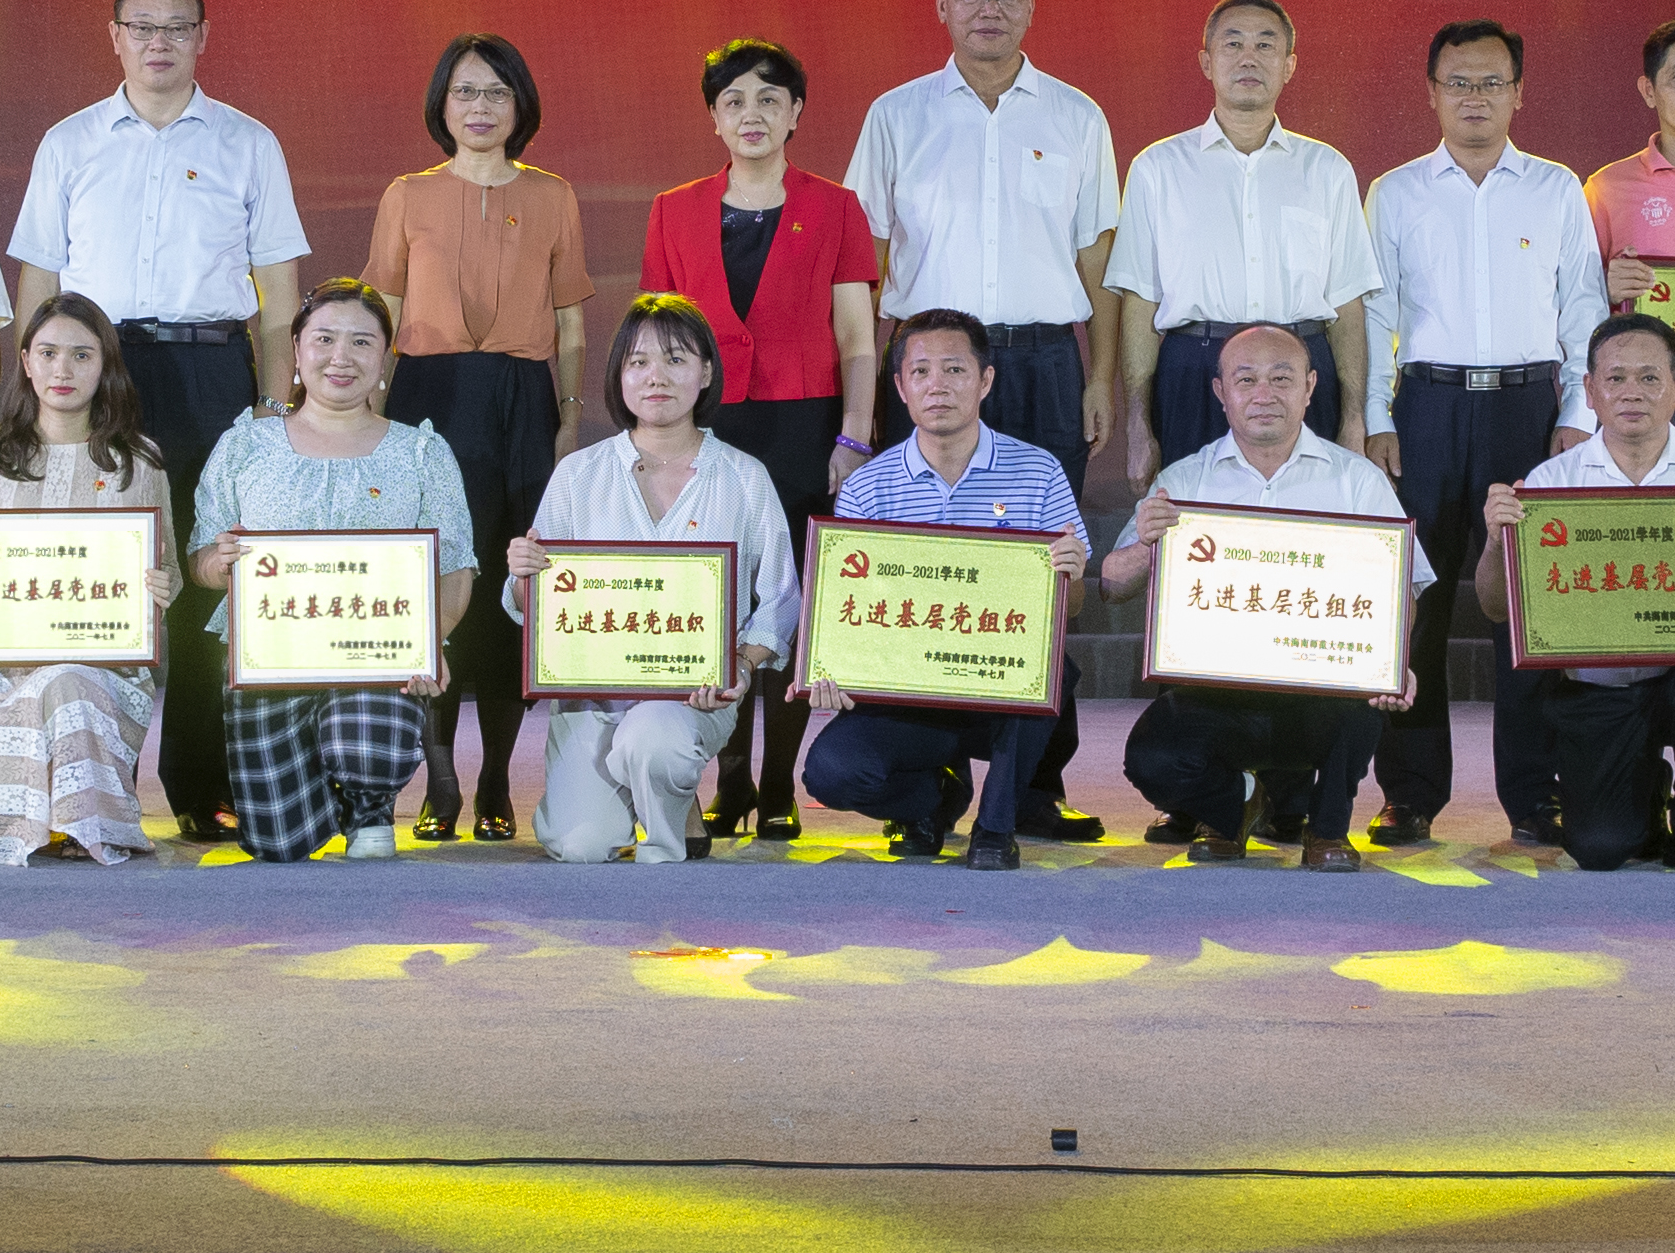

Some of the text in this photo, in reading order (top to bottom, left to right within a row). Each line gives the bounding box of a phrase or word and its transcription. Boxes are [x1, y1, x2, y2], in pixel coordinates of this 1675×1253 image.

[1575, 526, 1674, 543] 2020-2021学年度
[7, 546, 88, 558] 2020-2021学年度
[1224, 547, 1326, 569] 2020-2021学年度
[285, 561, 368, 574] 2020-2021学年度
[877, 563, 979, 584] 2020-2021学年度
[583, 578, 665, 591] 2020-2021学年度
[258, 593, 411, 620] 先进基层党组织
[1187, 578, 1373, 619] 先进基层党组织
[555, 608, 705, 635] 先进基层党组织
[839, 594, 1027, 634] 先进基层党组织
[1273, 636, 1373, 653] 中共海南师范大学委员会
[924, 650, 1026, 668] 中共海南师范大学委员会
